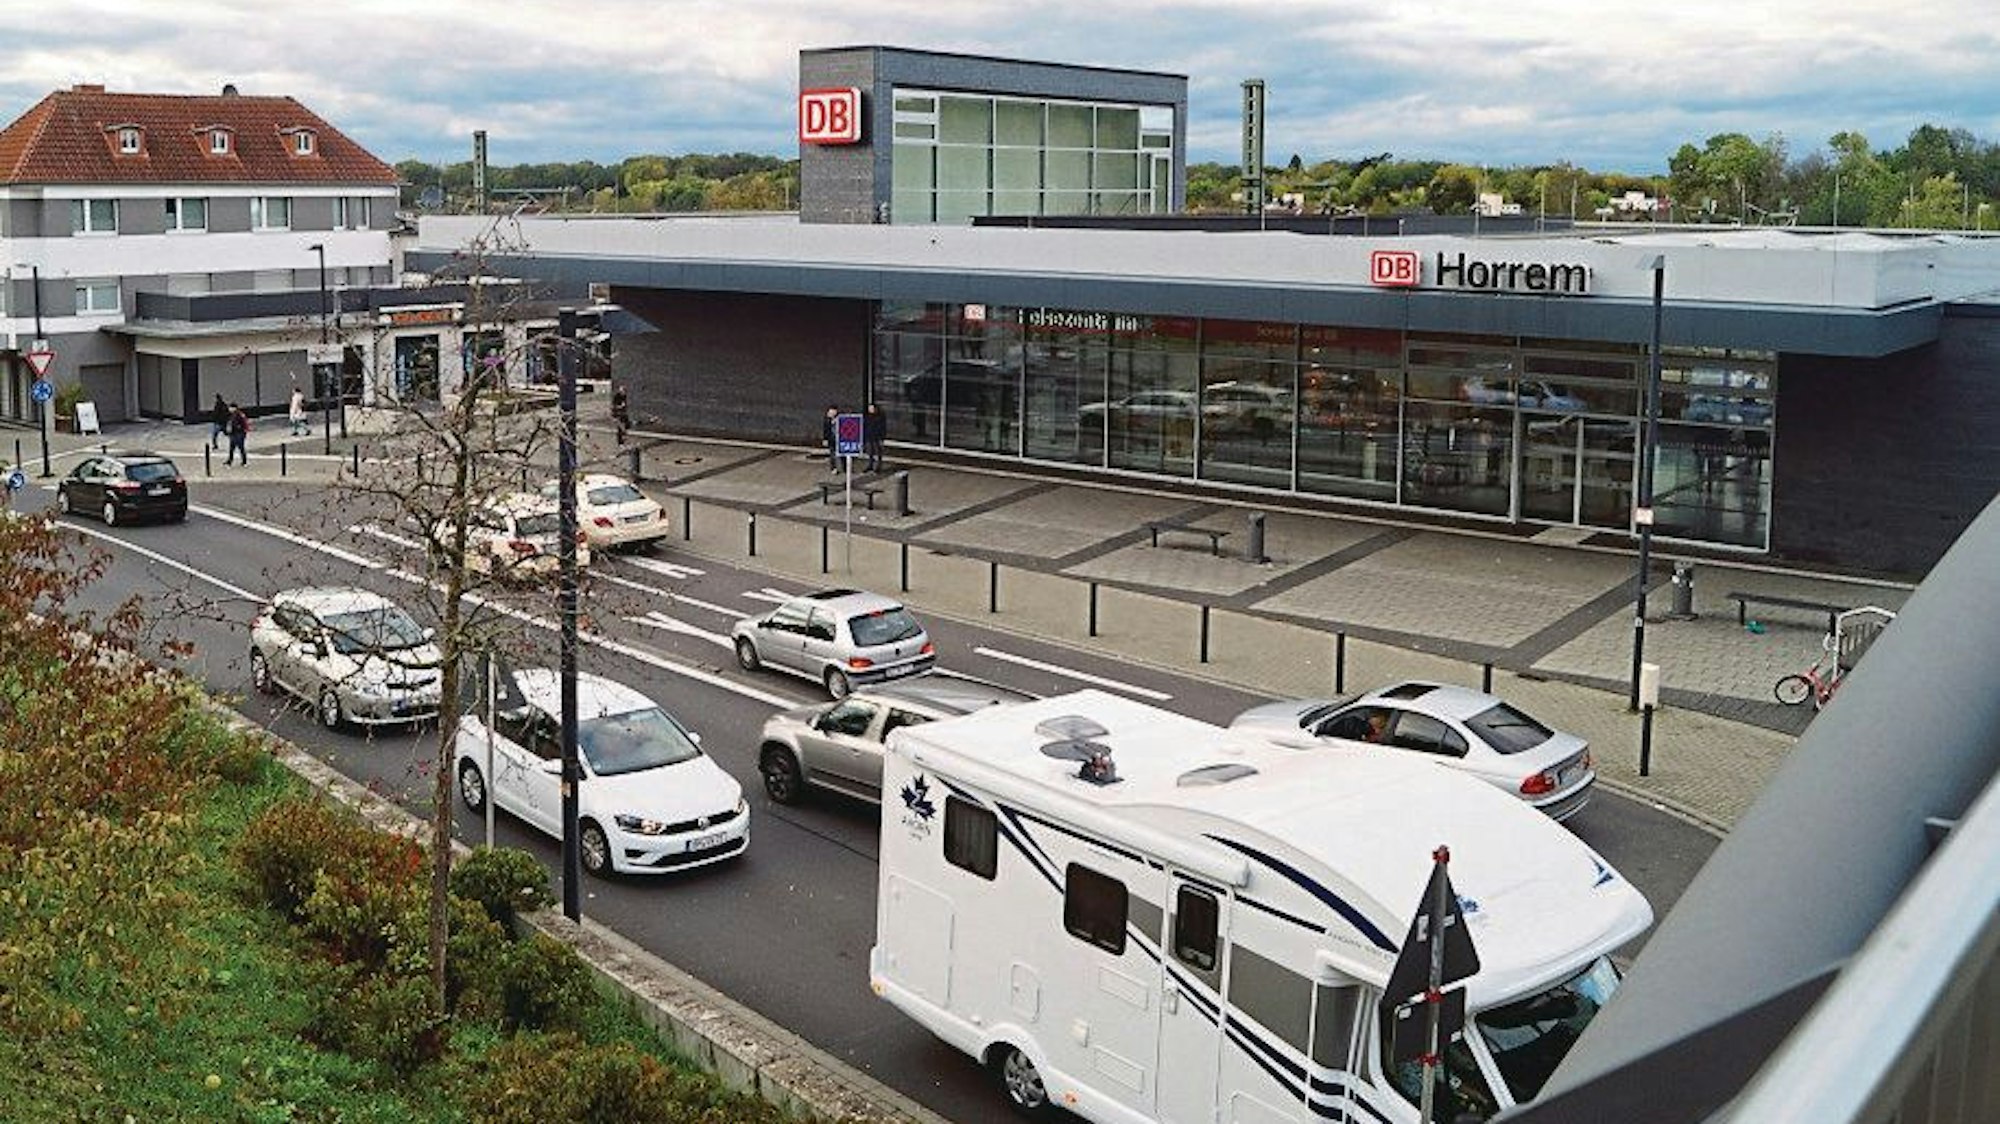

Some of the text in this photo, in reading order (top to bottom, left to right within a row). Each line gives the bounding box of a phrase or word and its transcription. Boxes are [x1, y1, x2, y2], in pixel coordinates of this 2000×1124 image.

[807, 100, 847, 132] DB
[1377, 252, 1586, 291] DB Horrem
